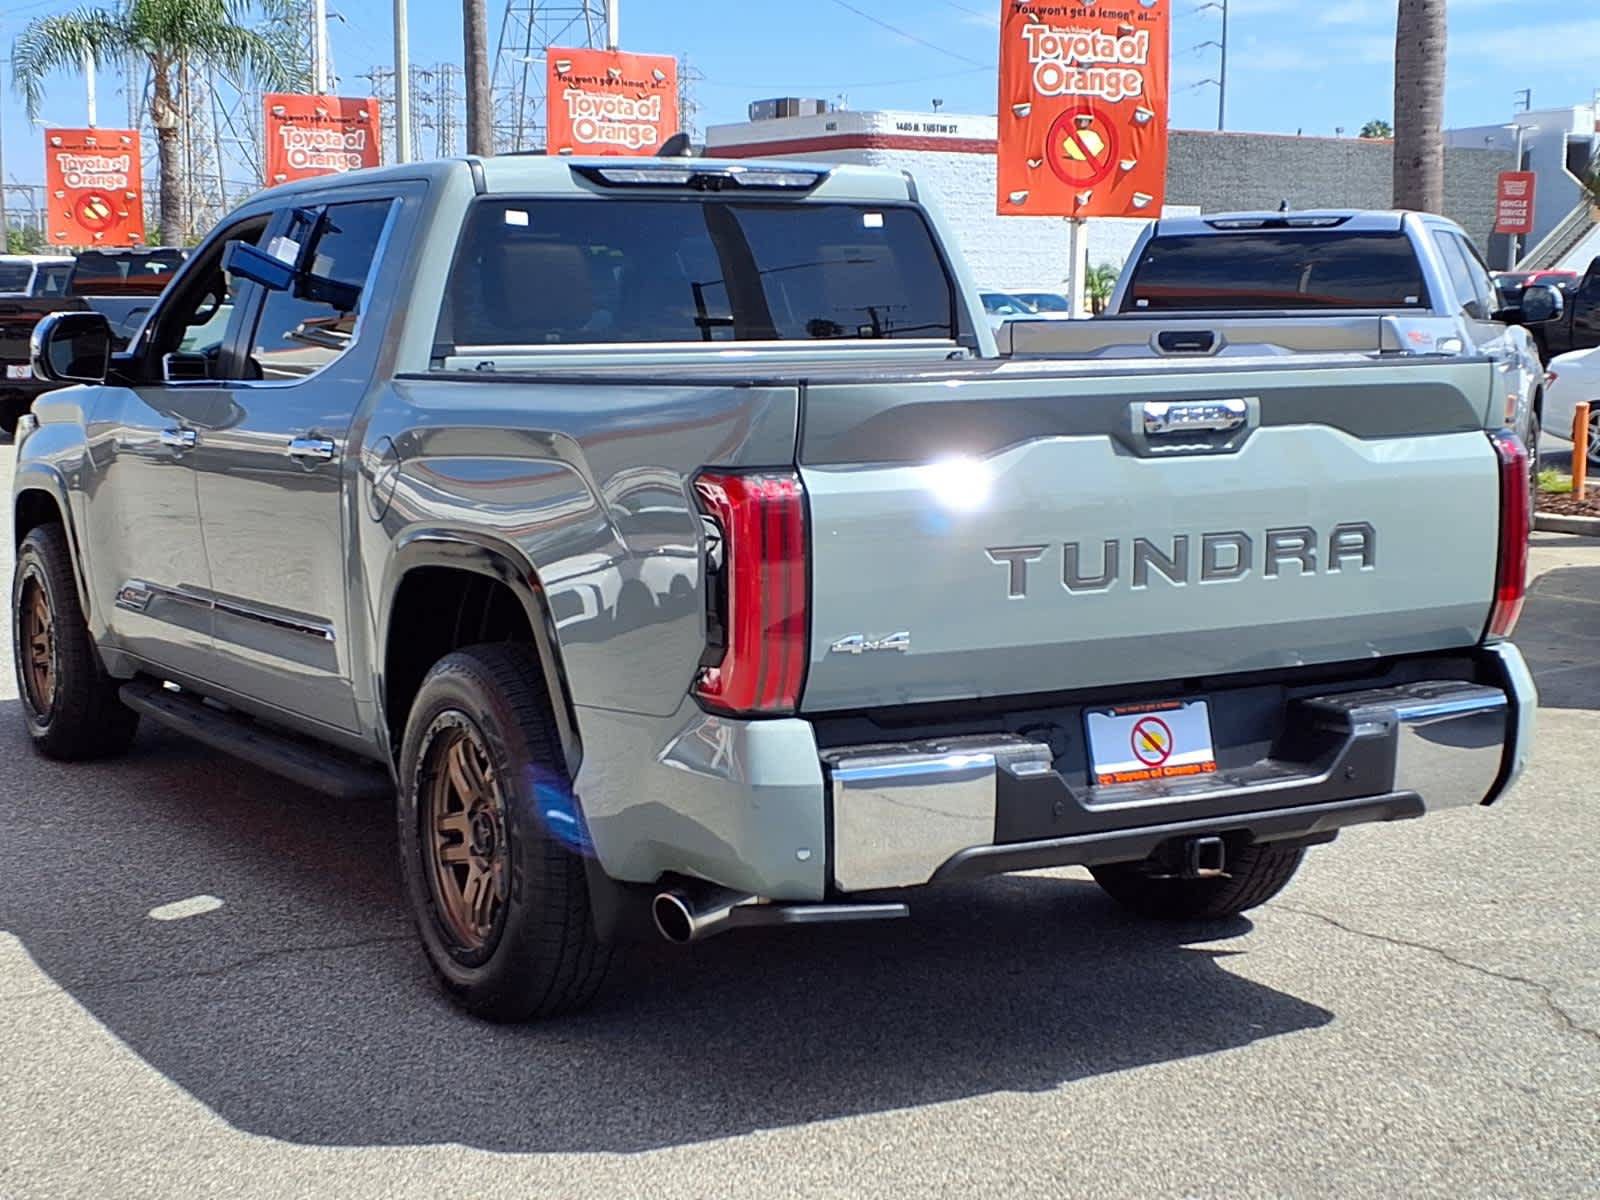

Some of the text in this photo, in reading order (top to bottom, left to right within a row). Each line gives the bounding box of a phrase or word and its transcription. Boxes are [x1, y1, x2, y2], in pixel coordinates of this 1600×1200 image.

[1039, 6, 1067, 17] won't
[1070, 8, 1087, 18] get
[1089, 9, 1096, 17] a
[1022, 25, 1149, 63] Toyota of
[1033, 61, 1143, 102] Orange
[563, 89, 660, 120] Toyota of
[279, 125, 365, 150] Toyota of
[573, 118, 656, 149] Orange
[56, 152, 129, 173] Toyota of
[287, 149, 361, 172] Orange
[64, 172, 127, 191] Orange
[984, 521, 1376, 599] TUNDRA
[831, 631, 909, 655] 4x4
